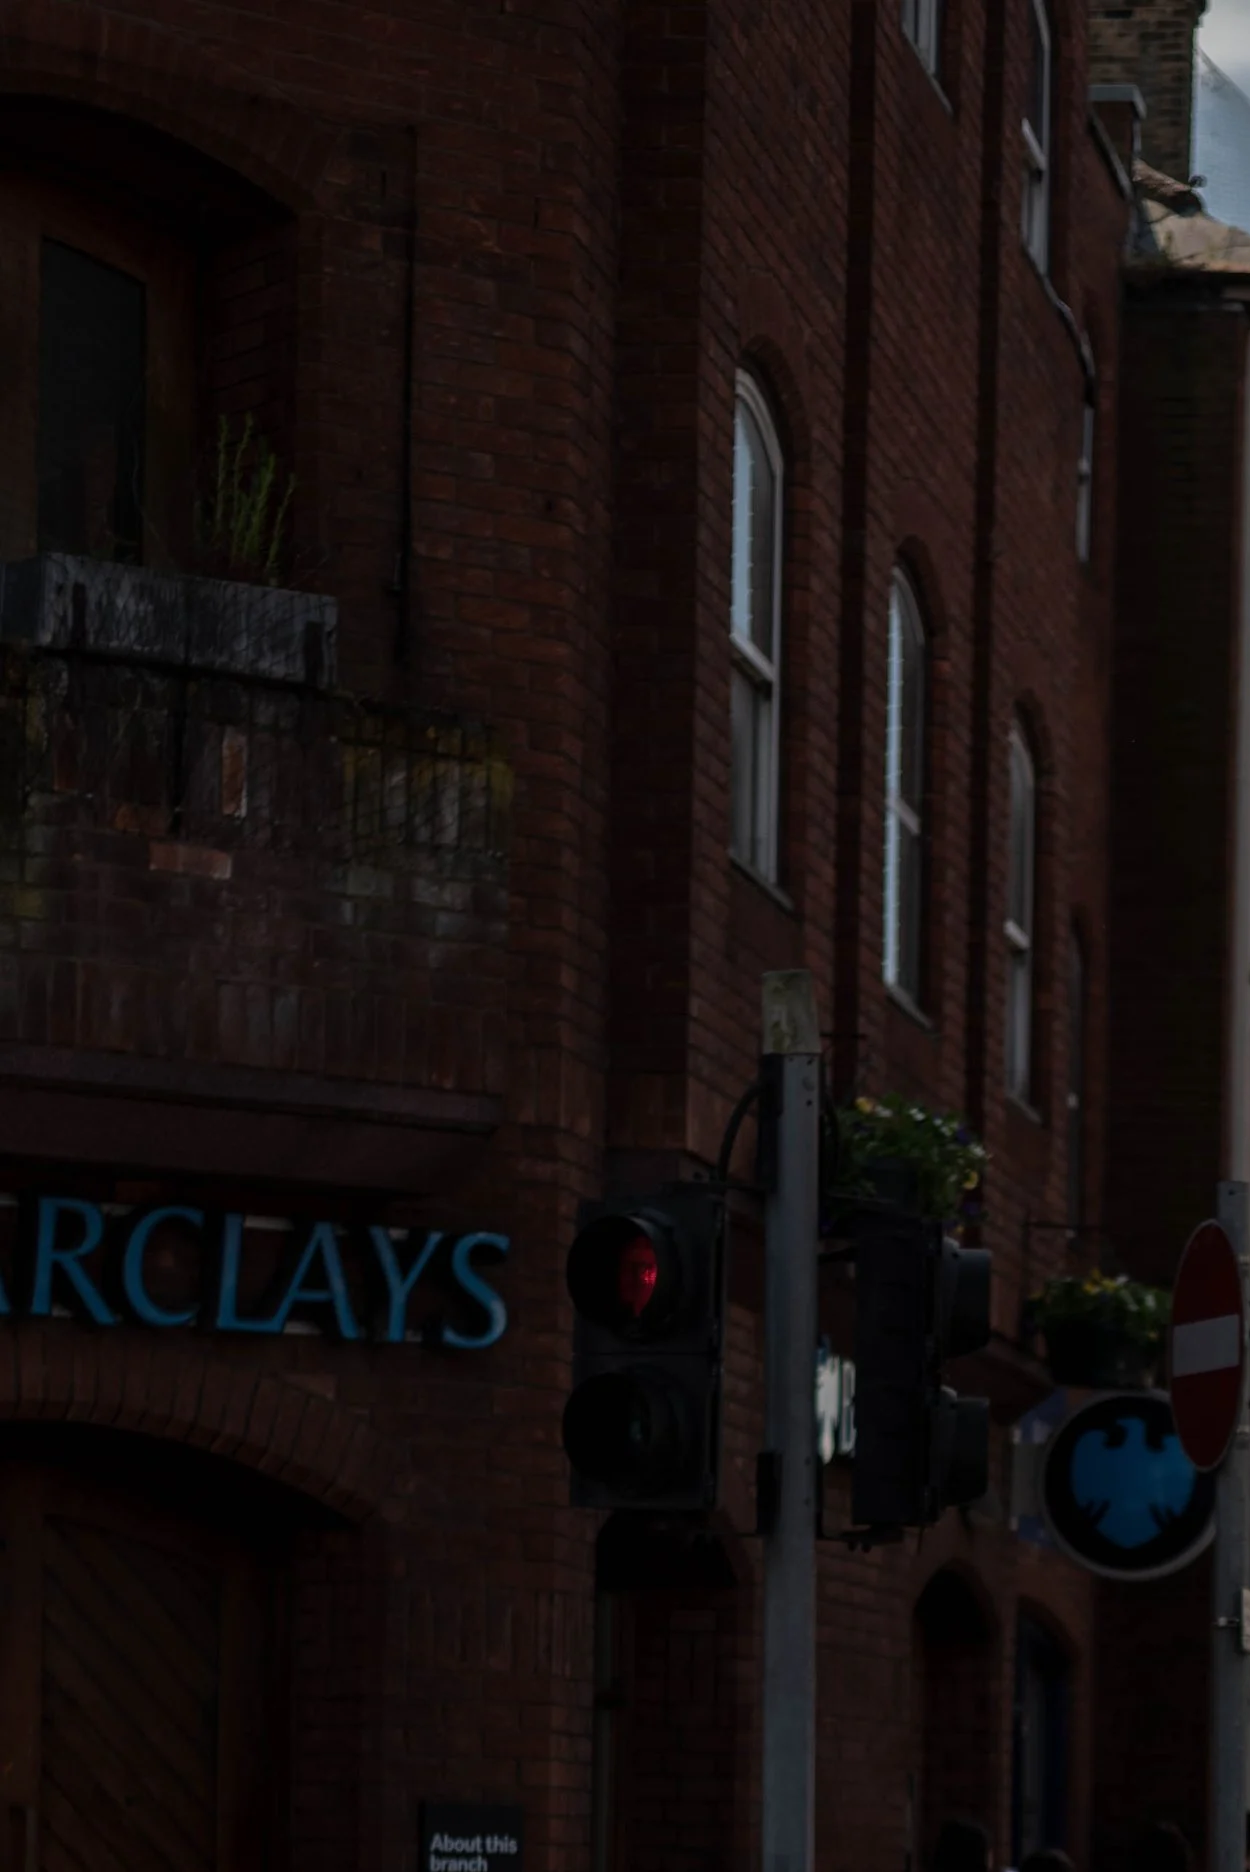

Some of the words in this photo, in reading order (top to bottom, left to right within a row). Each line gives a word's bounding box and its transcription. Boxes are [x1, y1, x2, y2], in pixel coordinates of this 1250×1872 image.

[0, 1193, 511, 1349] RCLAYS
[430, 1833, 482, 1853] About
[485, 1835, 518, 1855] this
[429, 1855, 489, 1872] branch
